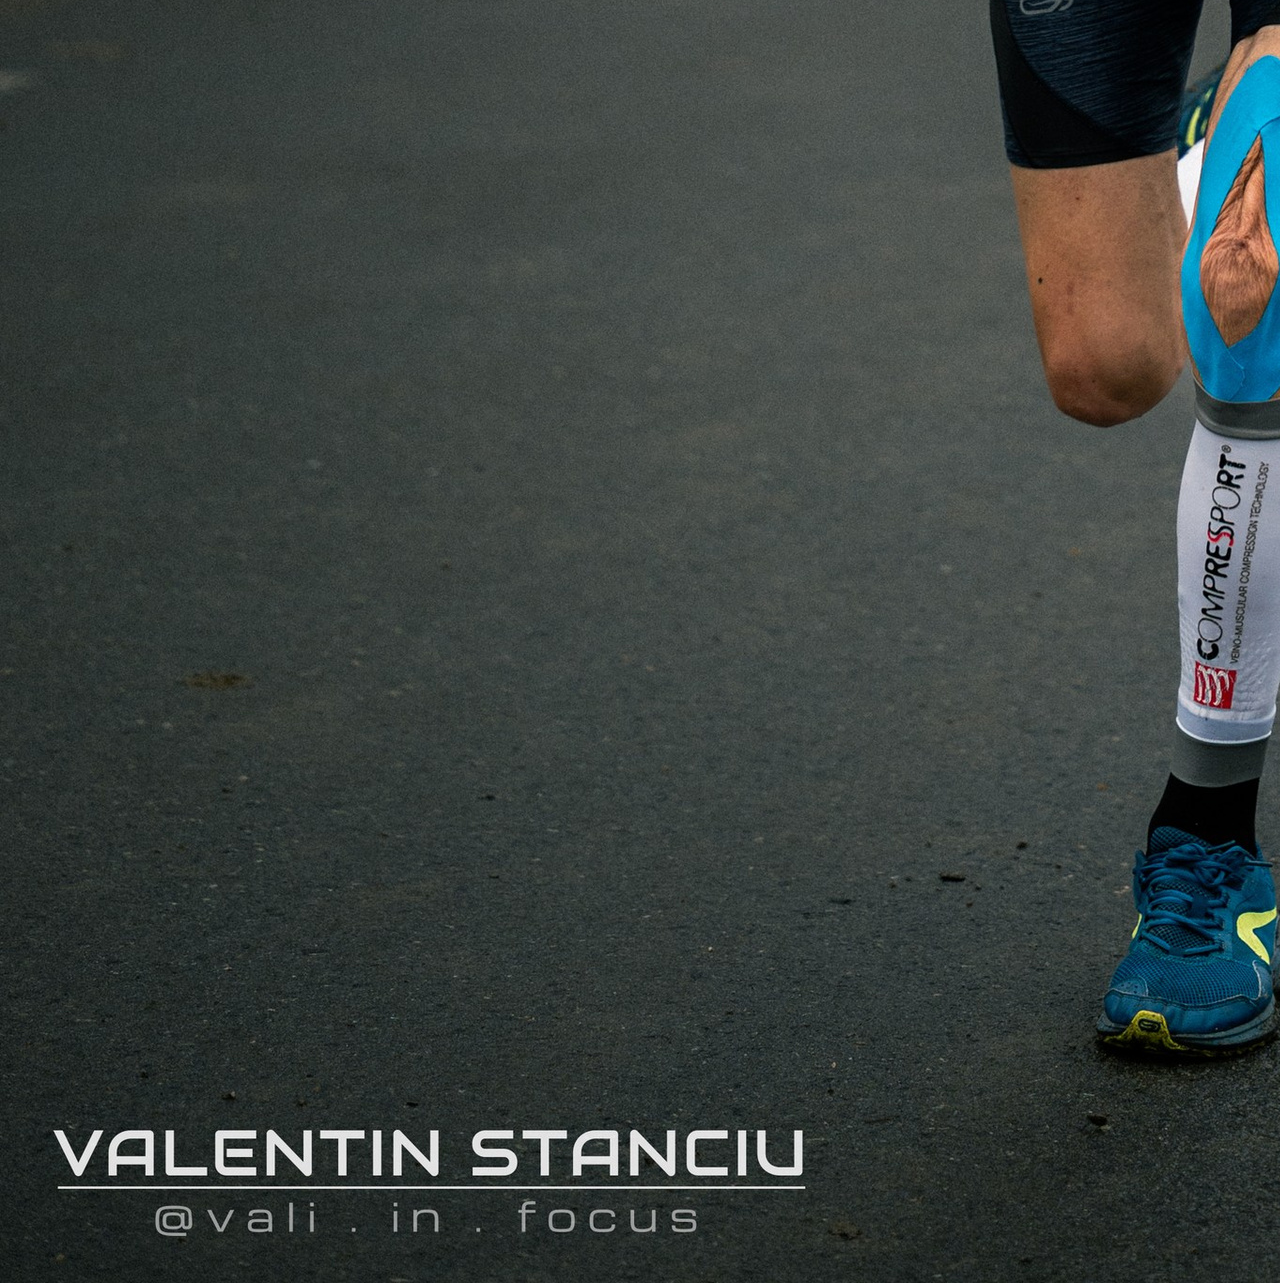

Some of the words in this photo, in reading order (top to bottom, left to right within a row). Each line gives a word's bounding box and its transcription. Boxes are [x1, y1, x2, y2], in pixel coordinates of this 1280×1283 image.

[1249, 461, 1269, 518] TECHNOLOGY
[1240, 520, 1259, 584] COMPRESSION
[1229, 585, 1248, 664] VEINO-MUSCULAR
